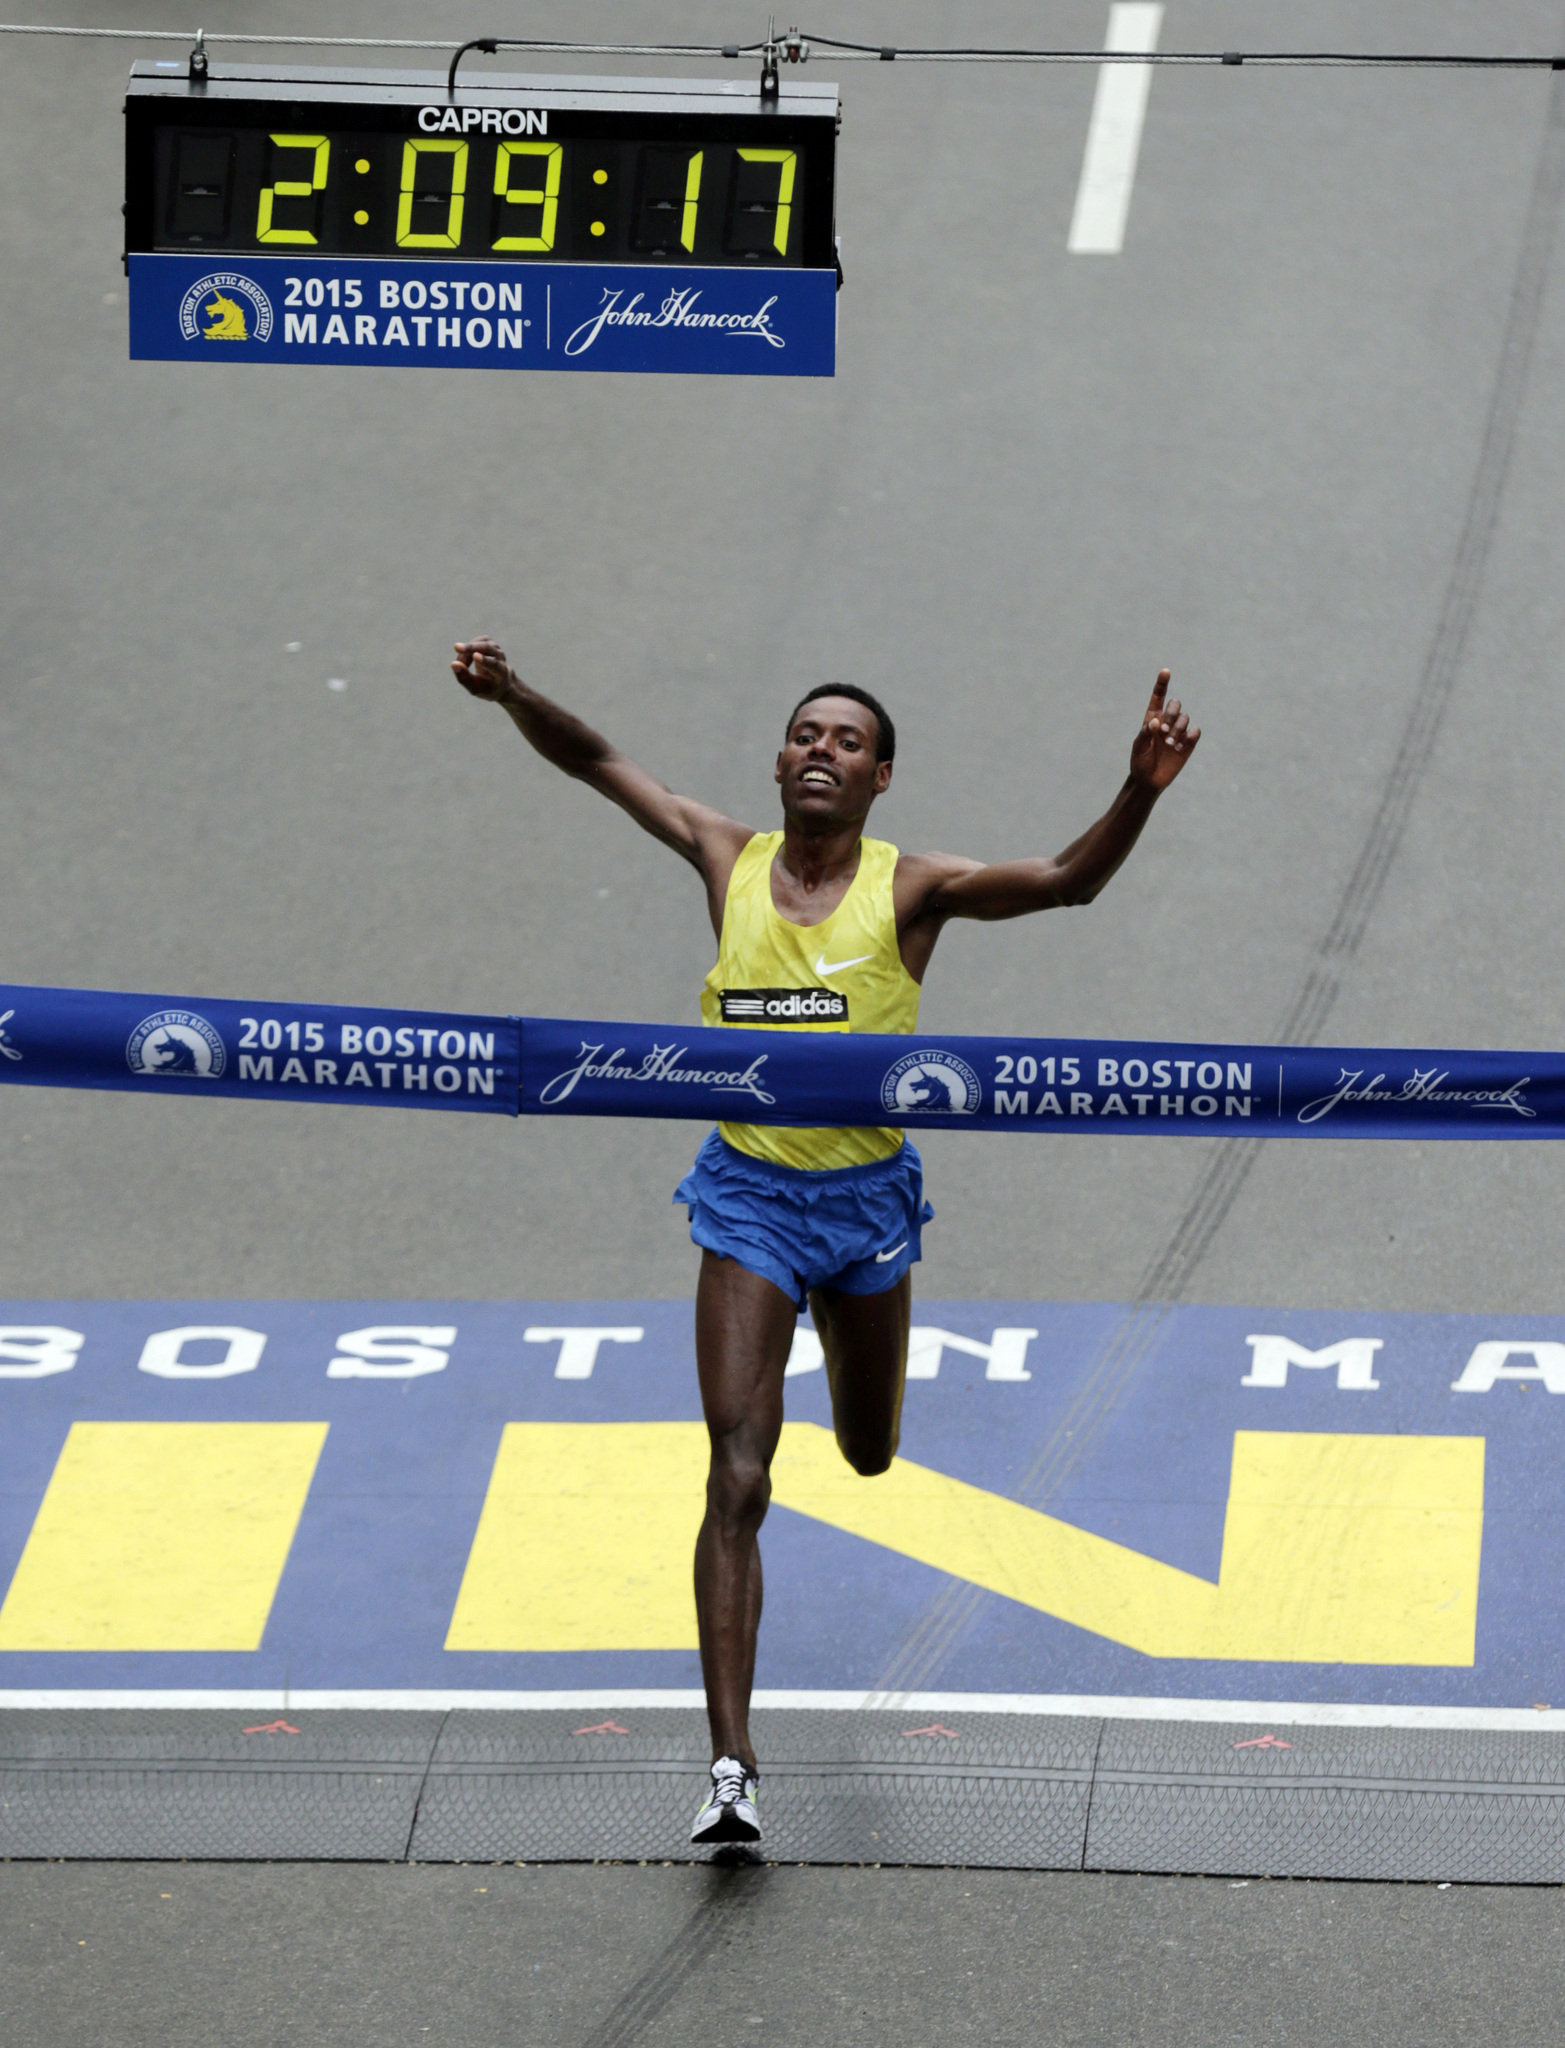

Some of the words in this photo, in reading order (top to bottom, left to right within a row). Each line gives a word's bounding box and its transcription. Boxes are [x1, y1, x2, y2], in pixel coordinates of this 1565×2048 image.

[418, 106, 548, 136] CAPRON
[256, 134, 797, 257] 2:09:17
[183, 296, 196, 335] BOSTON
[192, 276, 238, 298] ATHLETIC
[237, 279, 270, 336] ASSOCIATION
[284, 278, 363, 308] 2015
[379, 280, 523, 311] BOSTON
[284, 312, 524, 349] MARATHON
[565, 287, 651, 356] John
[651, 287, 786, 348] Hancock
[766, 991, 844, 1017] adidas
[238, 1018, 325, 1052] 2015
[340, 1024, 495, 1061] BOSTON
[238, 1054, 495, 1095] MARATHON
[539, 1041, 633, 1105] John
[632, 1043, 776, 1105] Hancock
[895, 1053, 944, 1075] ATHLETIC
[994, 1055, 1081, 1086] 2015
[1097, 1058, 1252, 1090] BOSTON
[993, 1090, 1252, 1117] MARATHON
[1297, 1068, 1392, 1124] John
[1392, 1068, 1537, 1118] Hancock
